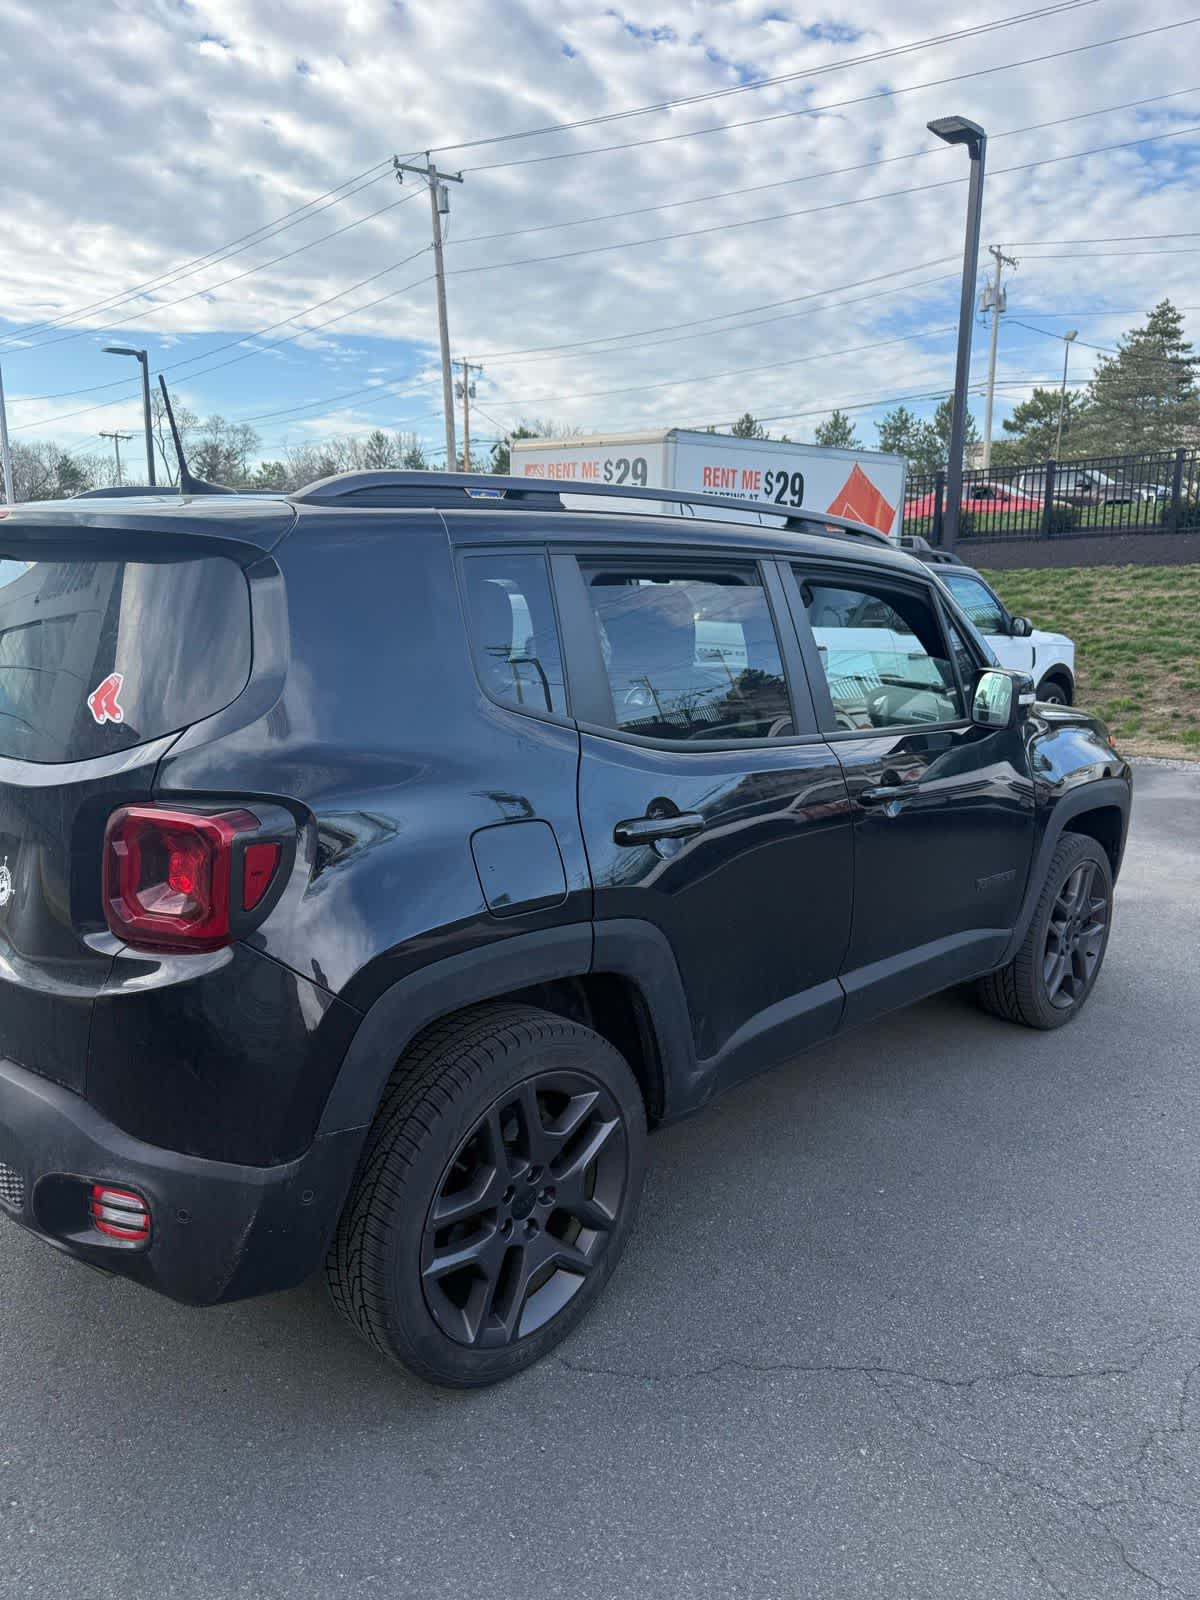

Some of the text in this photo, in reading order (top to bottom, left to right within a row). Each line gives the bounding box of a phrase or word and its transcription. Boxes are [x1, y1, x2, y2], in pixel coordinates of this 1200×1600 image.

[547, 462, 577, 479] RENT
[582, 461, 600, 478] ME
[603, 457, 648, 486] $29
[703, 466, 804, 507] RENT ME $29
